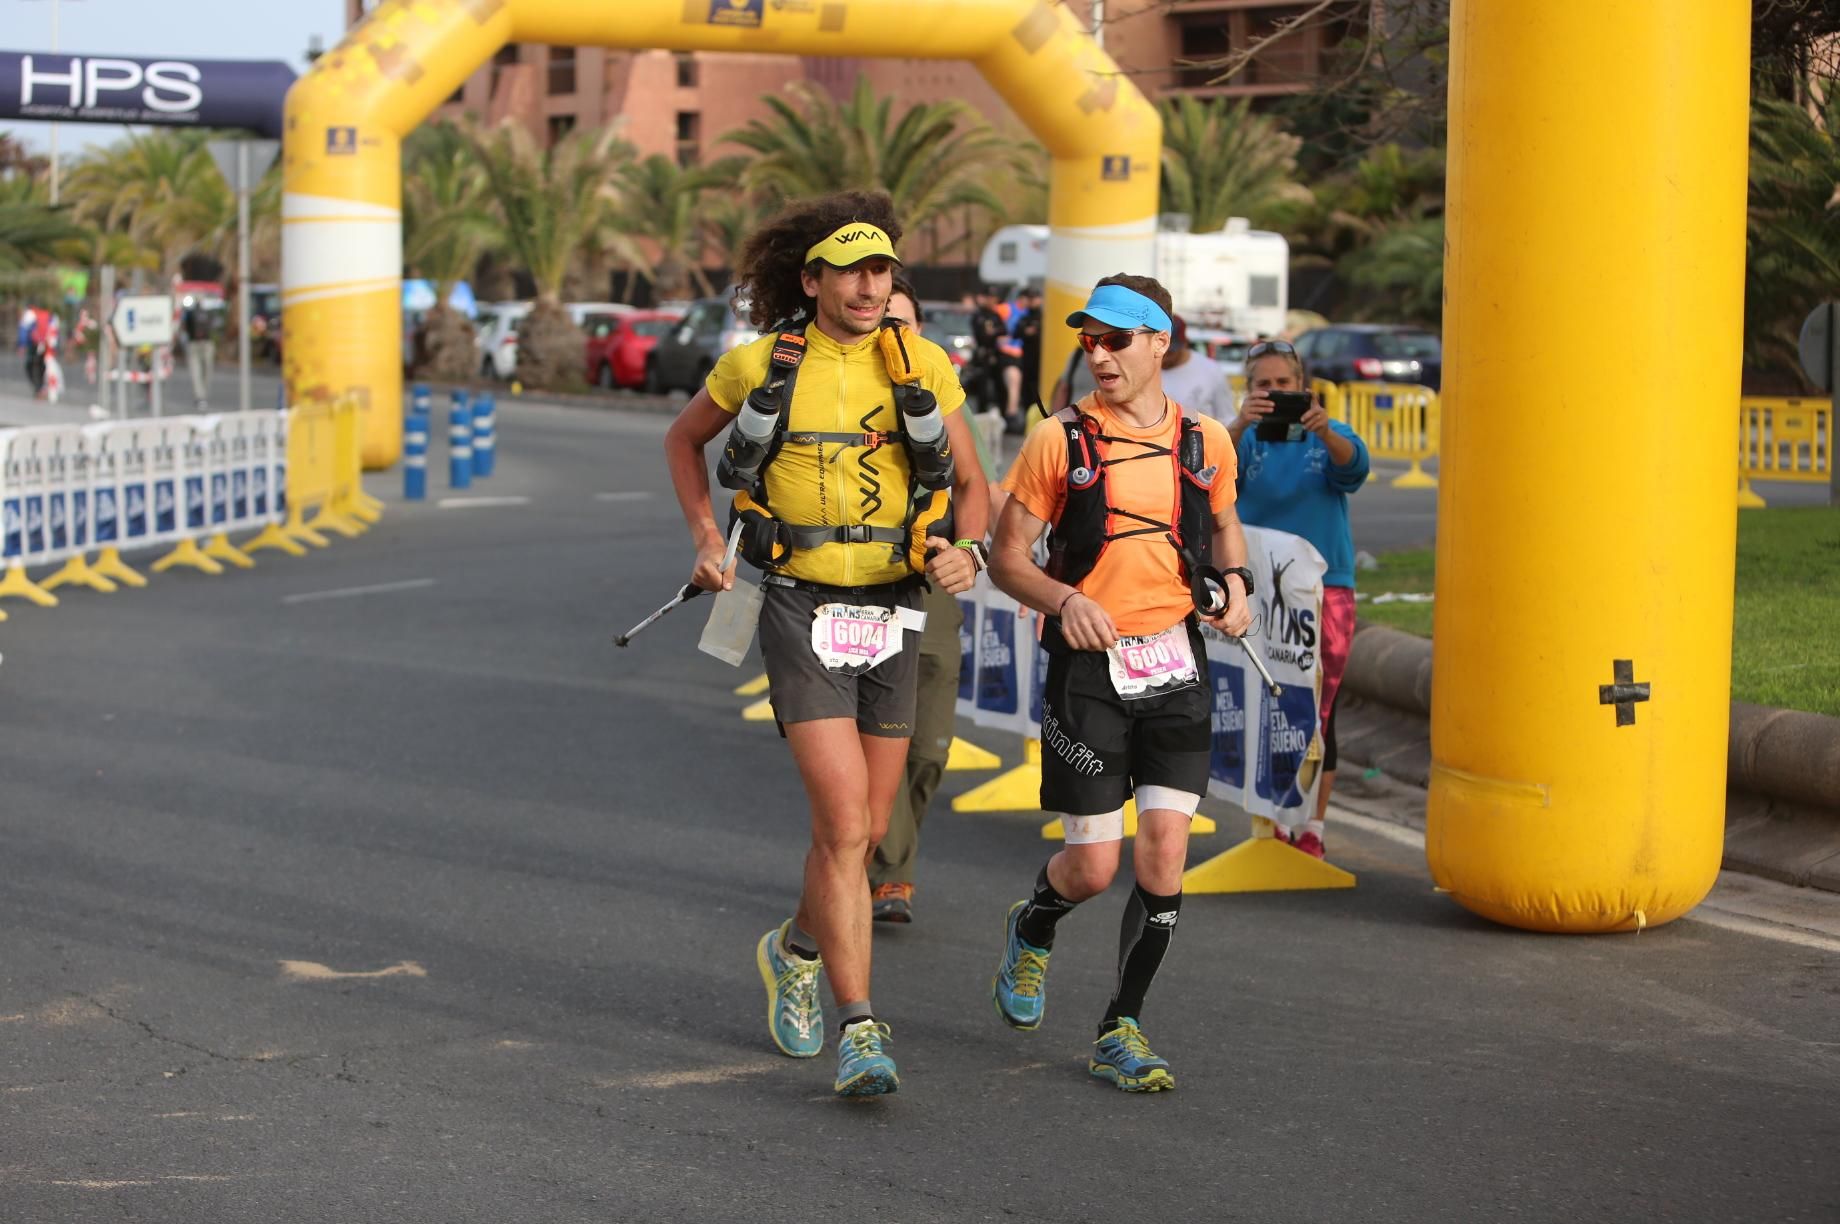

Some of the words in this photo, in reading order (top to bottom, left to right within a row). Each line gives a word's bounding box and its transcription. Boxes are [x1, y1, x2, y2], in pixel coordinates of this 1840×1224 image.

[20, 55, 202, 112] HPS
[834, 621, 884, 650] 6004
[1127, 636, 1180, 671] 6001
